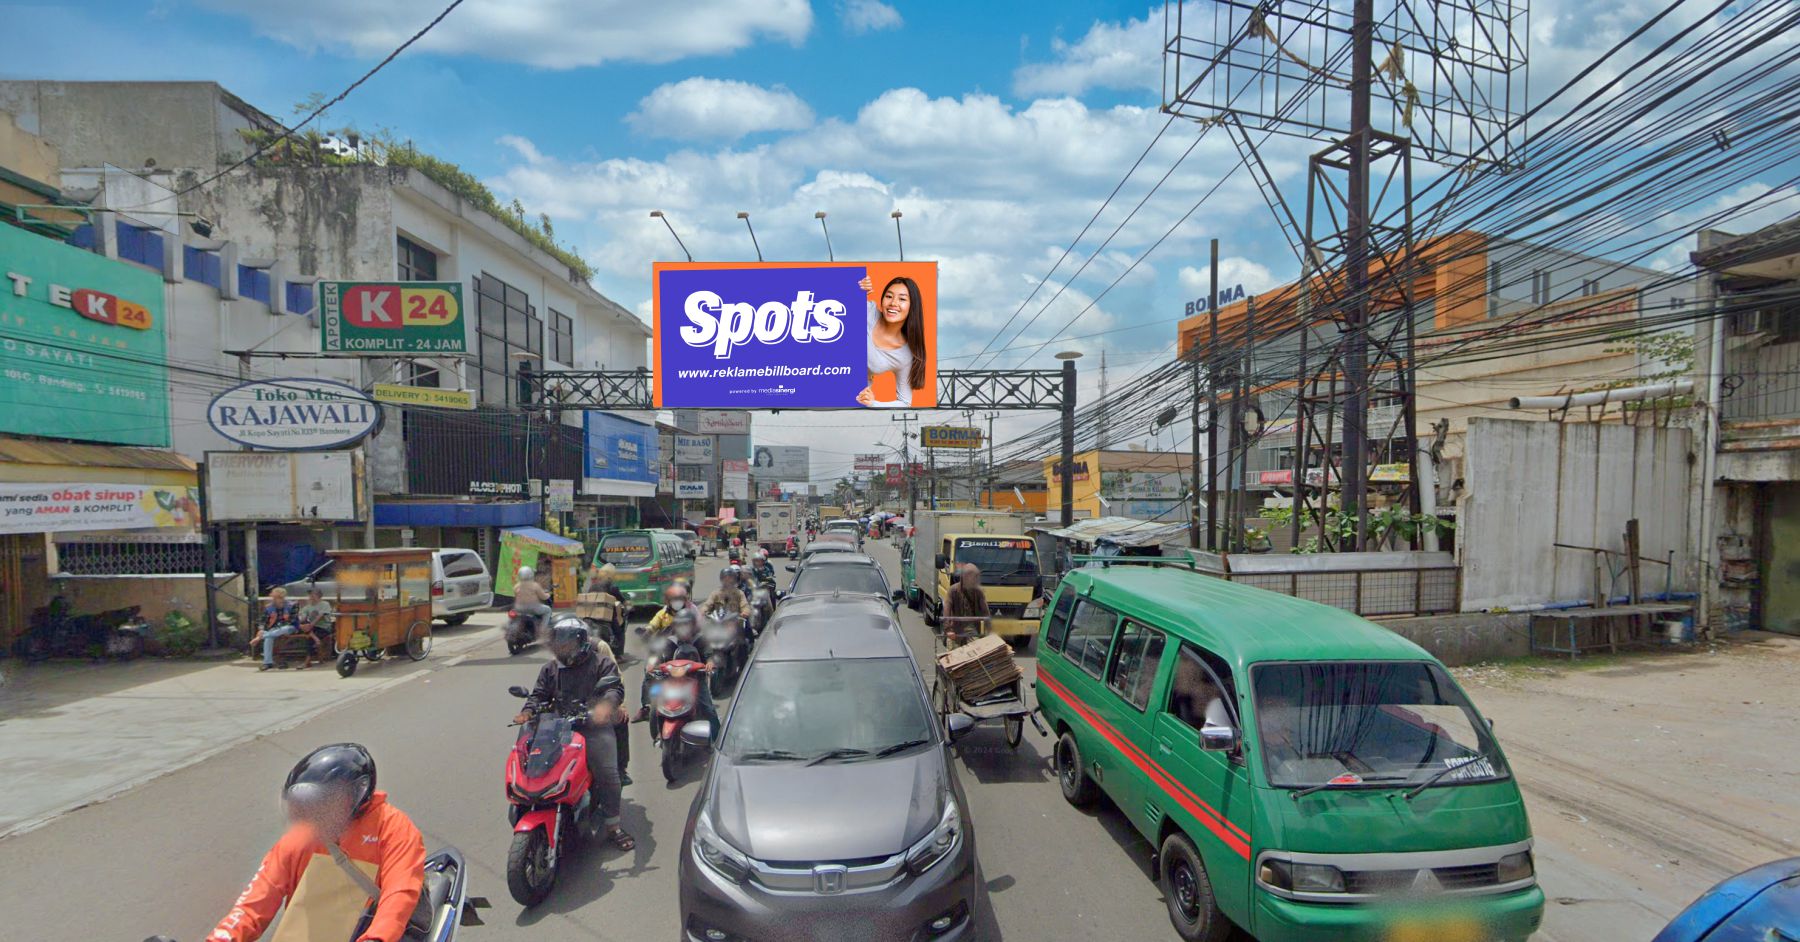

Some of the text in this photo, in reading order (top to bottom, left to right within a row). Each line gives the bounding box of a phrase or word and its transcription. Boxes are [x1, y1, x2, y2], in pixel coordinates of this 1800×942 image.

[87, 293, 108, 318] K
[122, 307, 147, 324] 24
[360, 291, 449, 322] K 24
[1185, 283, 1245, 317] BOMA
[326, 285, 338, 348] APOTEK
[680, 290, 846, 359] Spots
[24, 344, 94, 367] SAYATI
[345, 338, 405, 350] KOMPLIT
[416, 339, 431, 350] 24
[434, 338, 462, 350] JAM
[678, 365, 851, 379] www.reklamebillboard.com
[252, 387, 343, 401] Toko Mas
[375, 390, 420, 400] DELIVERY
[219, 403, 370, 427] RAJAWALI
[19, 494, 49, 502] sedia
[51, 489, 91, 502] obat
[94, 489, 136, 502] sirup
[5, 503, 134, 516] yang AMAN & KOMPLIT
